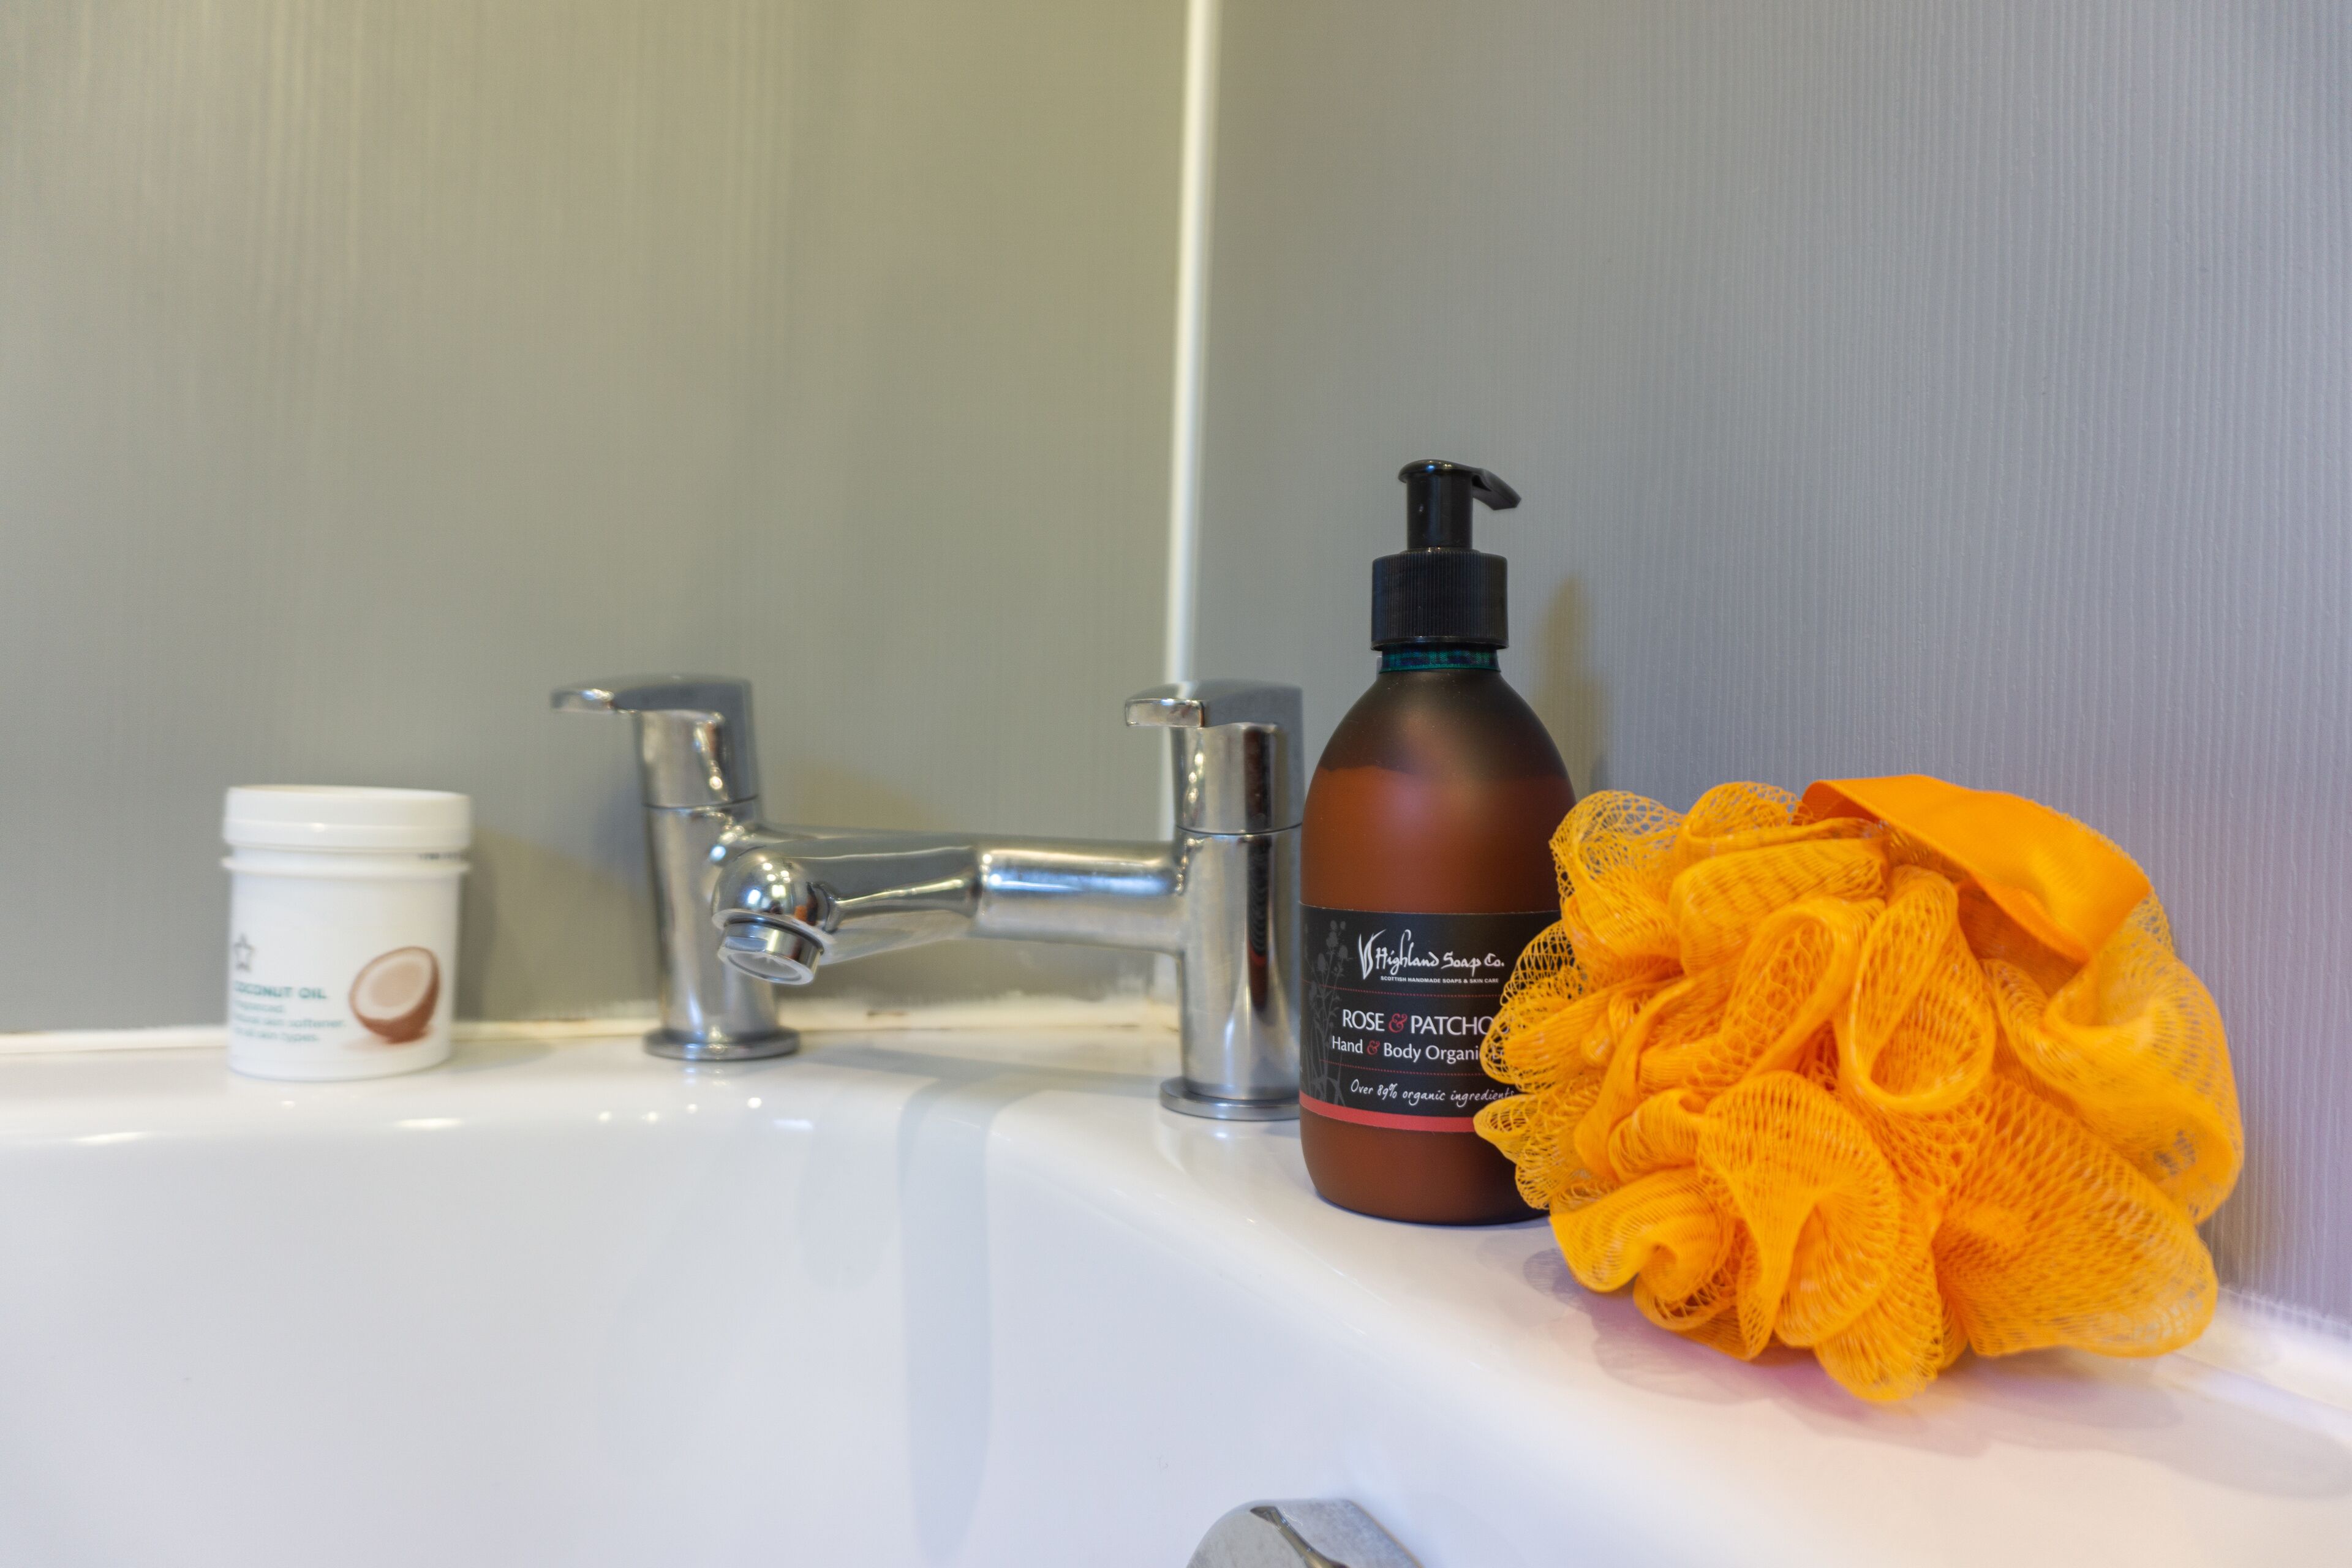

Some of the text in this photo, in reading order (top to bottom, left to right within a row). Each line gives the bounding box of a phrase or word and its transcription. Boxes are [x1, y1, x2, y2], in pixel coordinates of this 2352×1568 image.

[1376, 929, 1504, 977] Highland Soap Co.
[298, 987, 327, 1000] OIL
[1343, 1009, 1385, 1031] ROSE
[1388, 1013, 1408, 1033] &
[1332, 1036, 1363, 1054] Hand
[1366, 1040, 1380, 1055] &
[1384, 1042, 1422, 1063] Body
[1425, 1045, 1480, 1064] Organi
[1351, 1079, 1514, 1107] Over 89% organic ingredients
